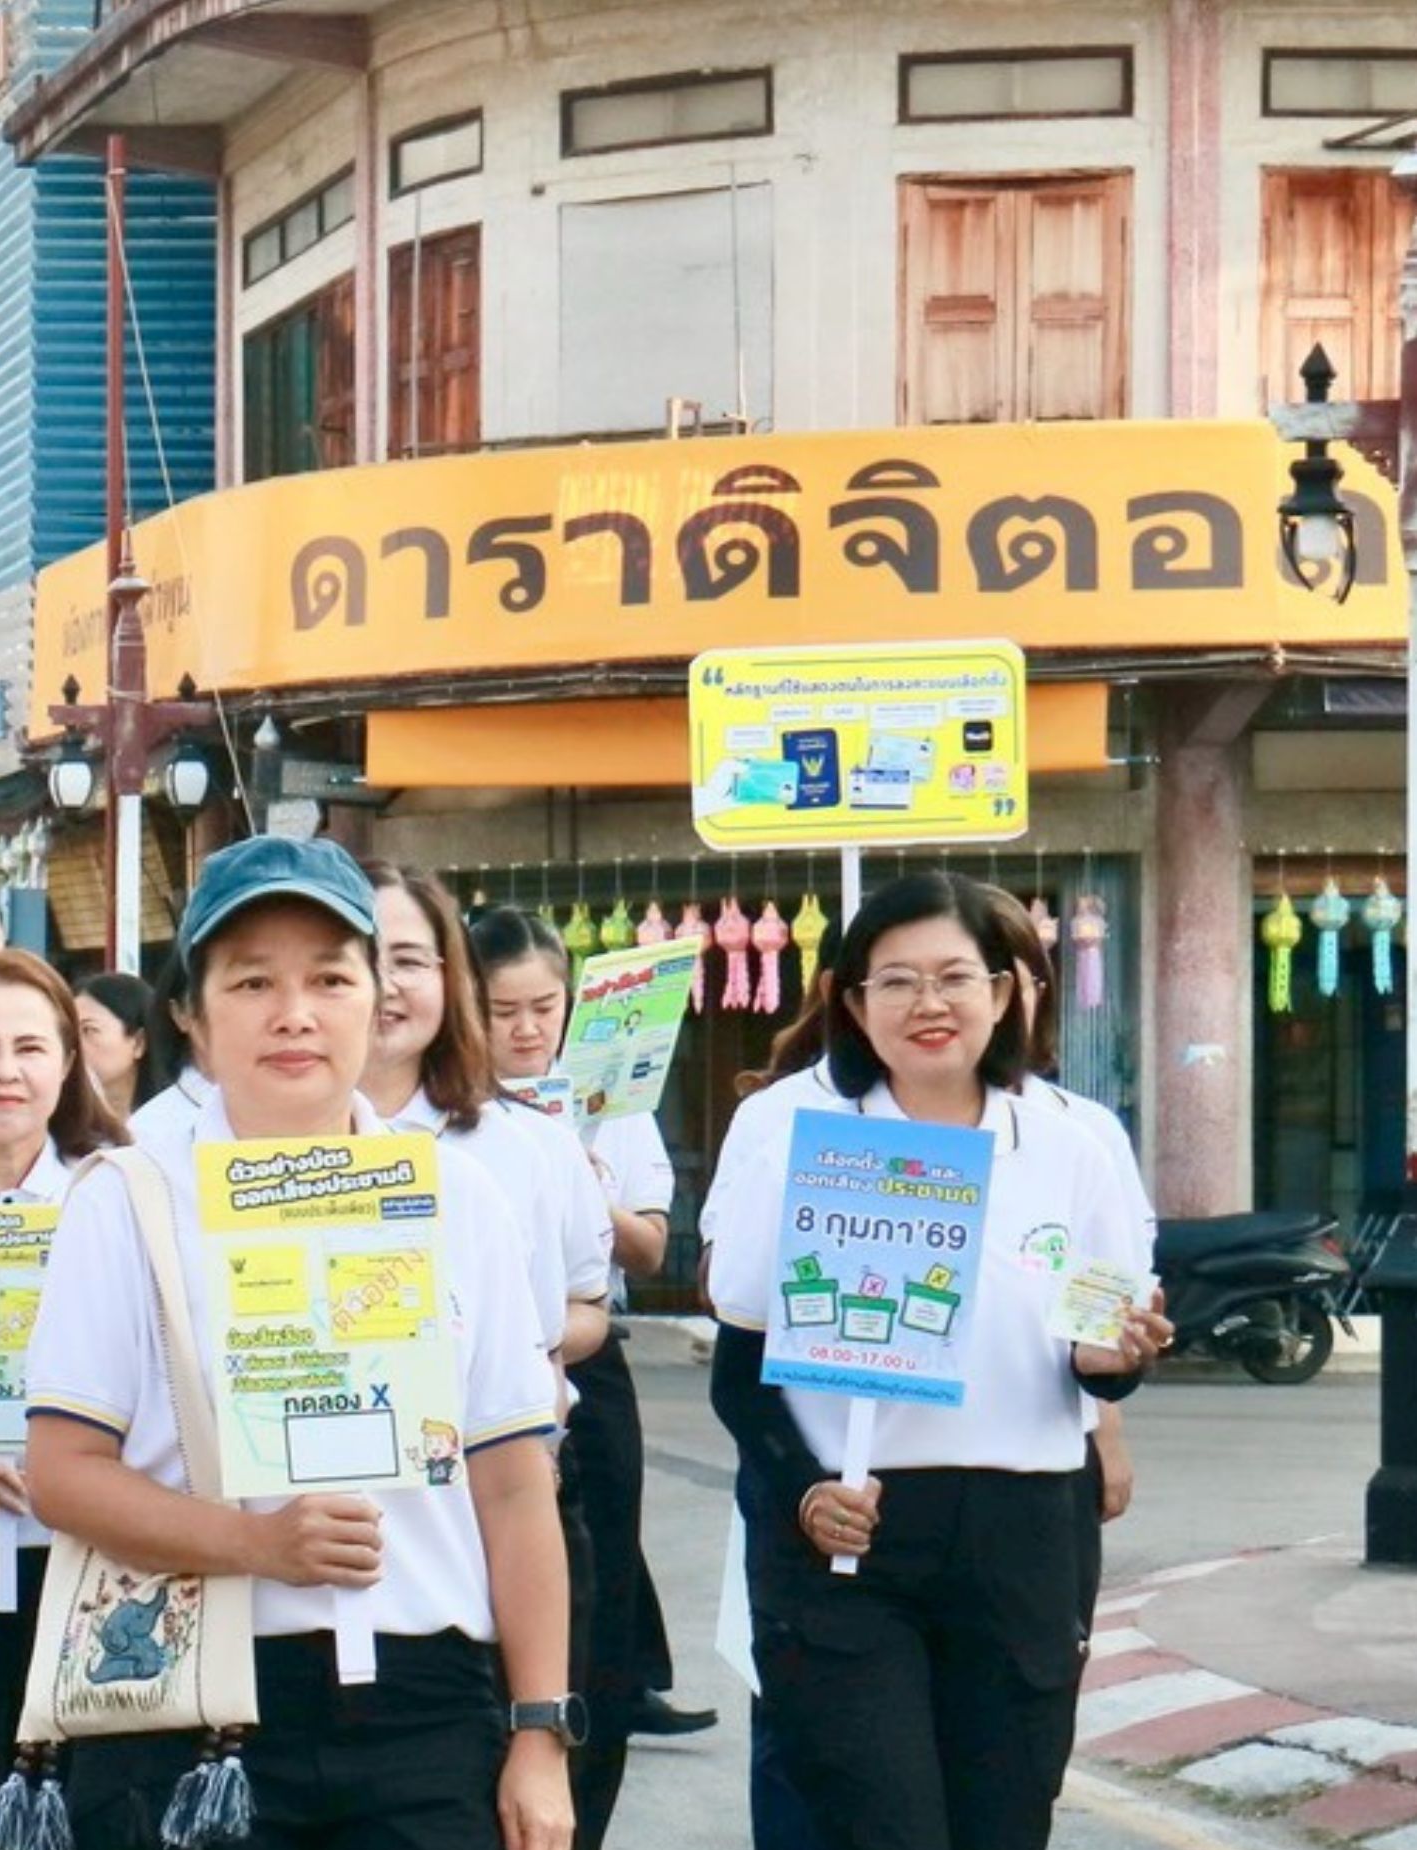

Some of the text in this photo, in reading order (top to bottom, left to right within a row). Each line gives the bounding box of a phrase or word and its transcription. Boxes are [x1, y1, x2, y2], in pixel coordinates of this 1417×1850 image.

[228, 1147, 352, 1183] ตัวอย่างบัตร
[817, 1148, 885, 1170] เลือกตั้ง
[232, 1160, 415, 1210] ออกเสียงประชามติ
[793, 1170, 979, 1205] ออกเสียง ประชามติ
[796, 1205, 815, 1232] 8
[284, 1383, 391, 1413] ทดลอง X
